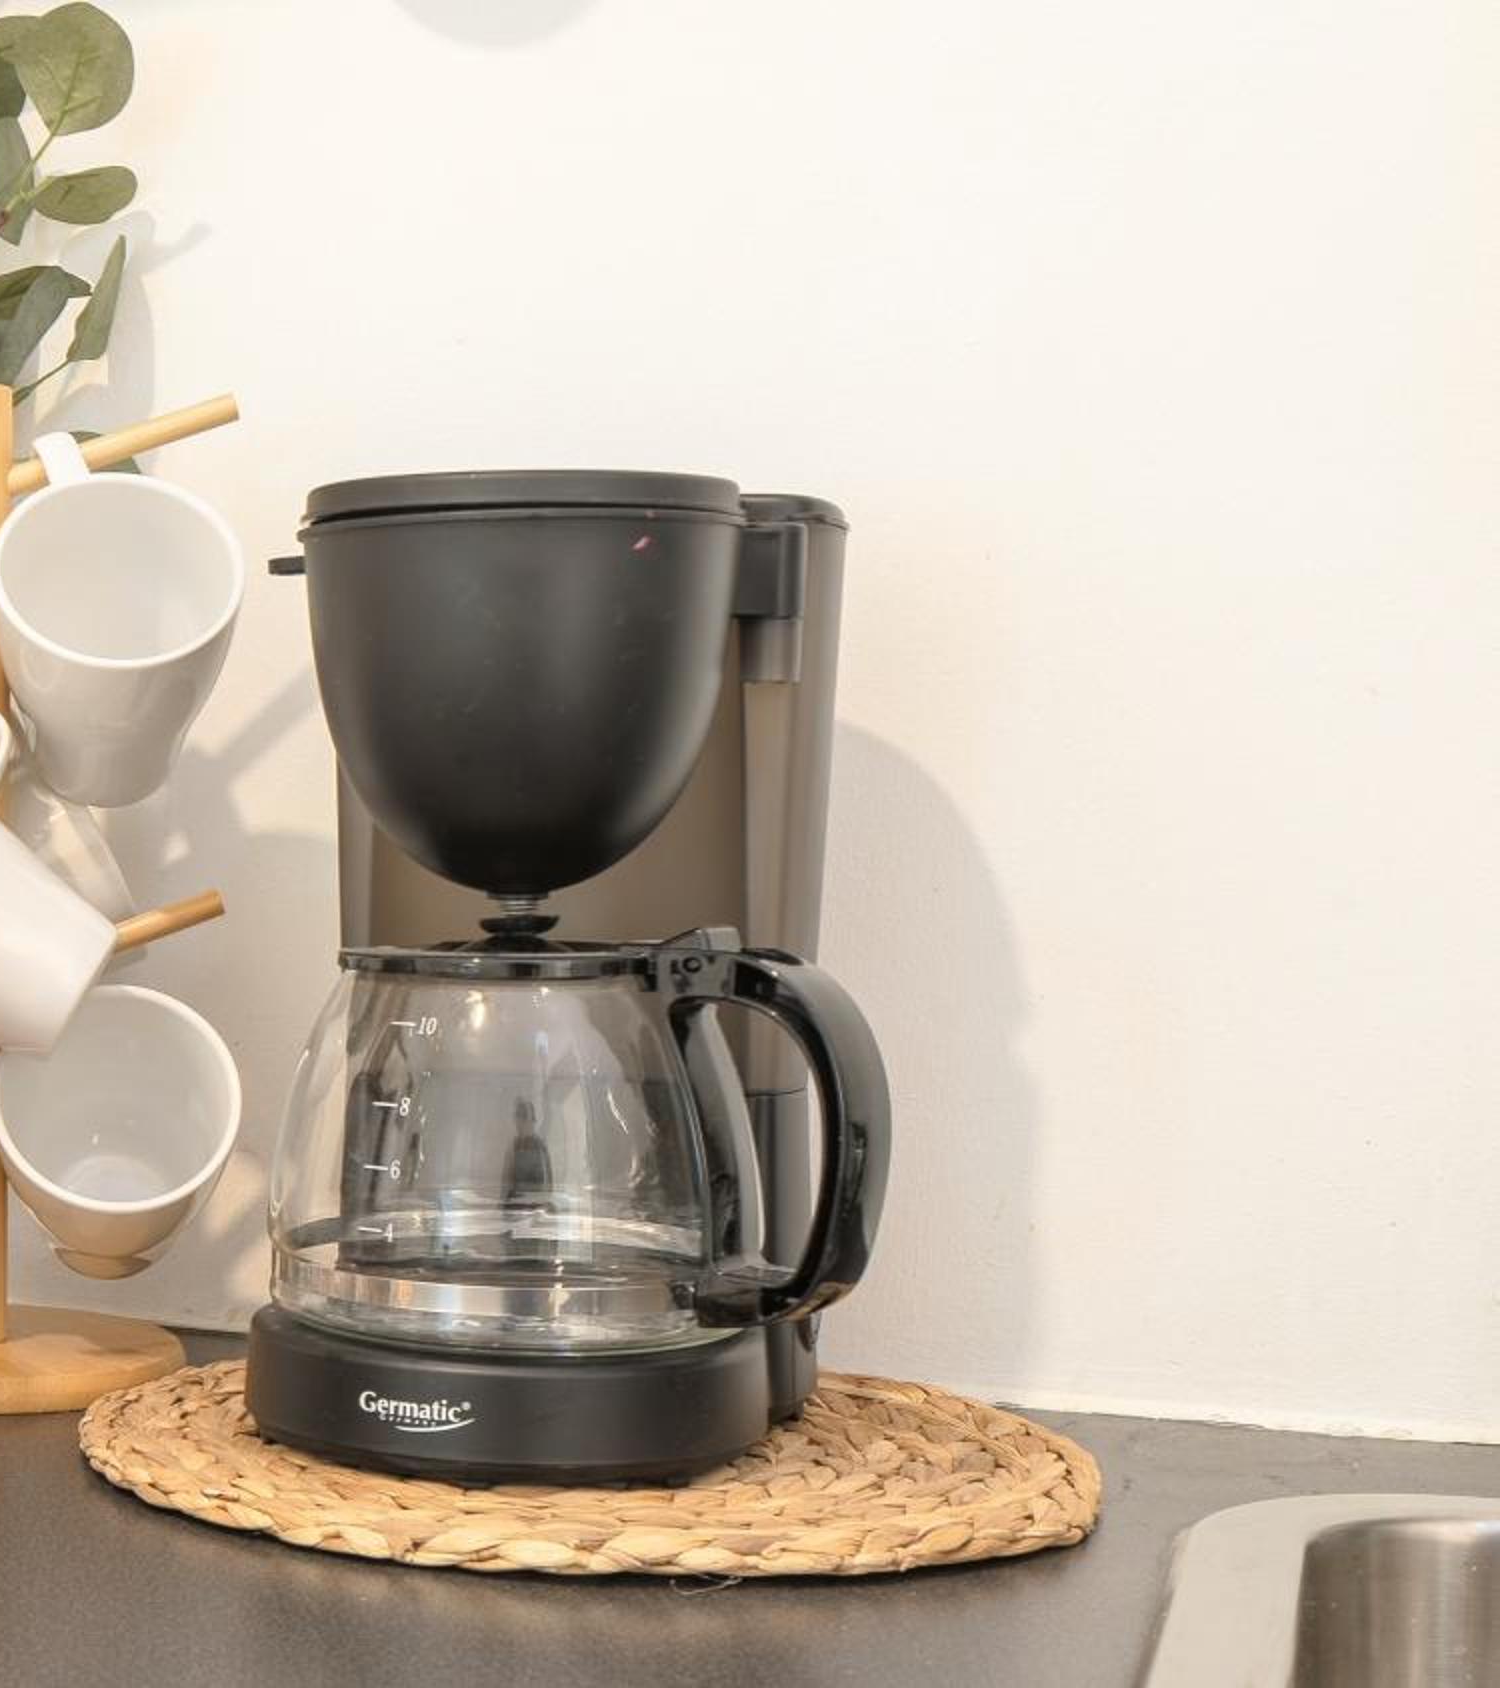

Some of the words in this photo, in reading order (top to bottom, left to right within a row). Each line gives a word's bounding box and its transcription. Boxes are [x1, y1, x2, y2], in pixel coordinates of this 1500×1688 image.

[417, 1017, 438, 1036] 10
[399, 1097, 411, 1117] 8
[389, 1159, 401, 1180] 6
[382, 1223, 394, 1243] 4
